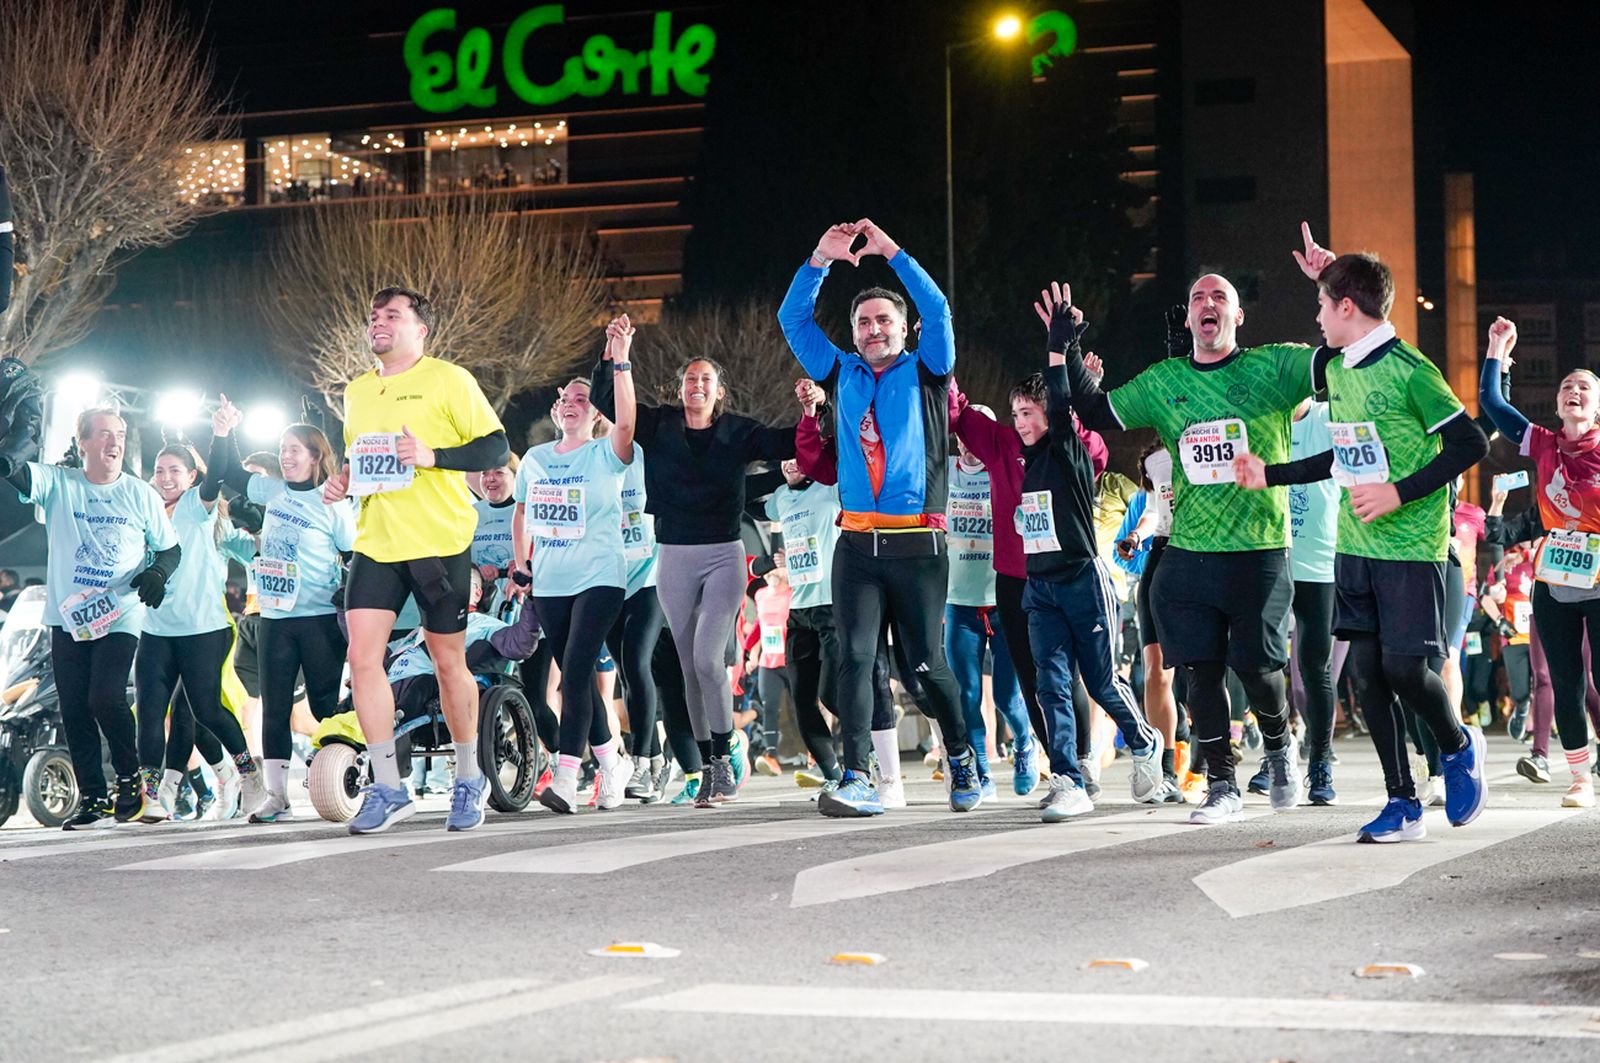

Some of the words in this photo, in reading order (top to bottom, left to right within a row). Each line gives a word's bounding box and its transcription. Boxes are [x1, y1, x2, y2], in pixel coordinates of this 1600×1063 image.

[404, 8, 497, 113] El
[503, 4, 716, 106] Corte
[1192, 442, 1235, 463] 3913
[531, 503, 578, 521] 13226
[789, 551, 819, 570] 13226
[1549, 547, 1594, 570] 13799
[74, 565, 114, 578] SUPERANDO
[260, 575, 295, 593] 13226
[70, 596, 116, 627] 13226
